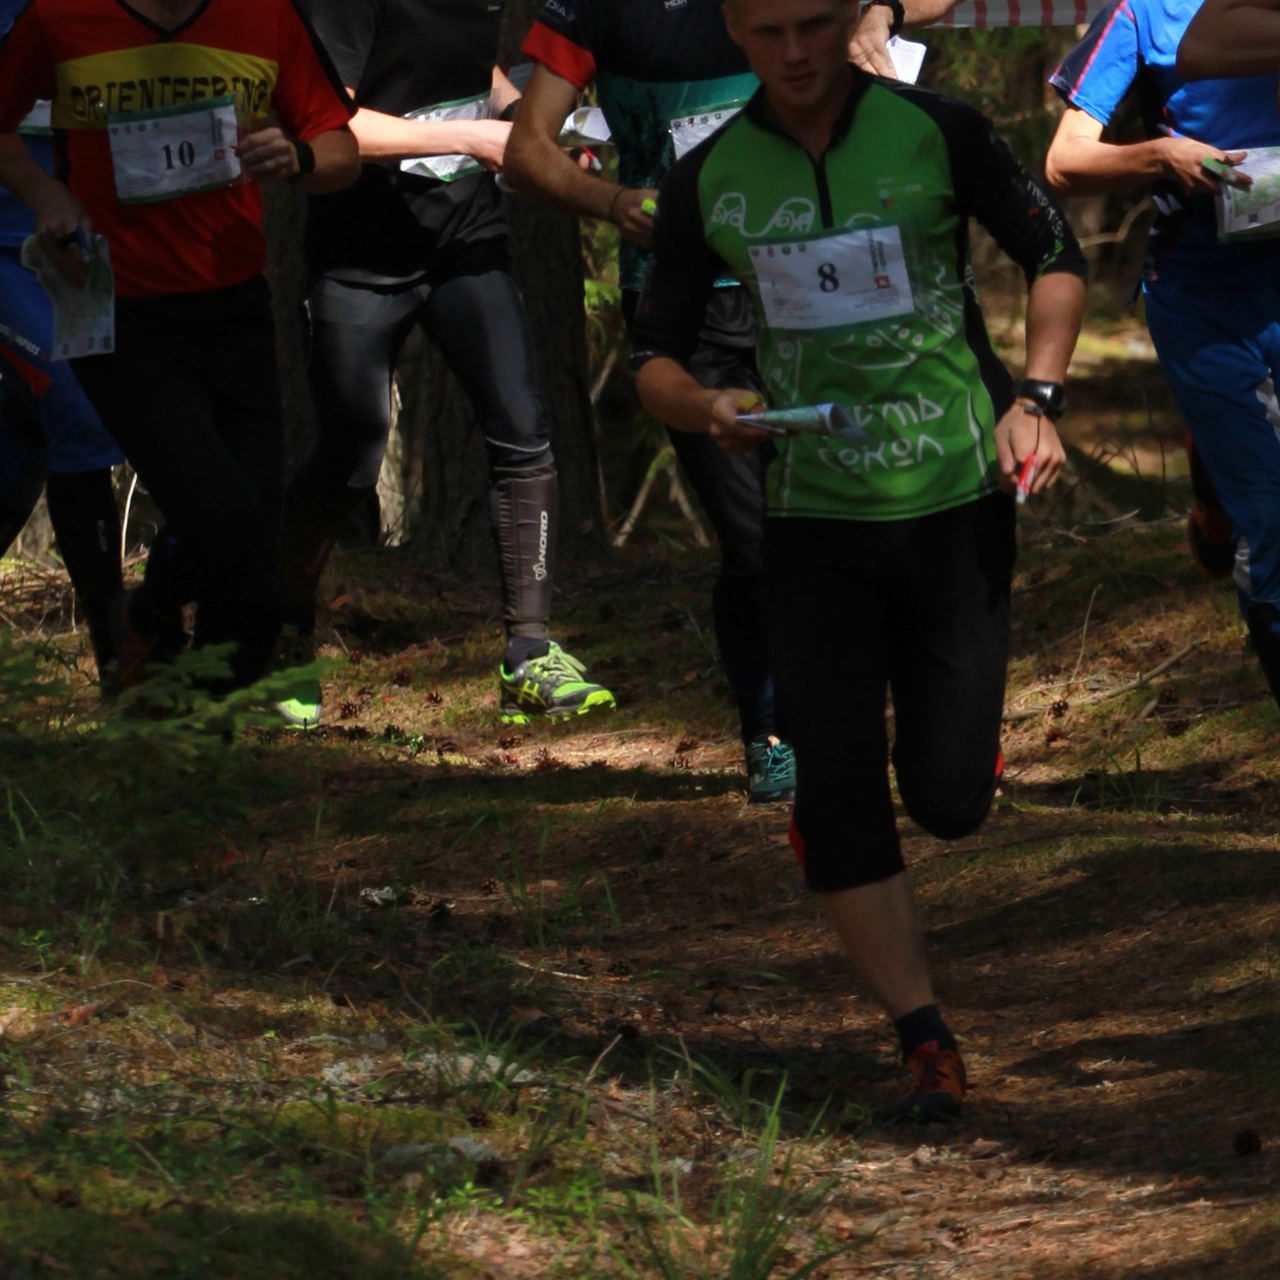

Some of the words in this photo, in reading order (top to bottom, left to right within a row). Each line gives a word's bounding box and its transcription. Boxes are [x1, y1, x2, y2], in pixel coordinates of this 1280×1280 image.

[162, 140, 196, 170] 10
[817, 262, 840, 292] 8
[538, 510, 549, 562] NORD
